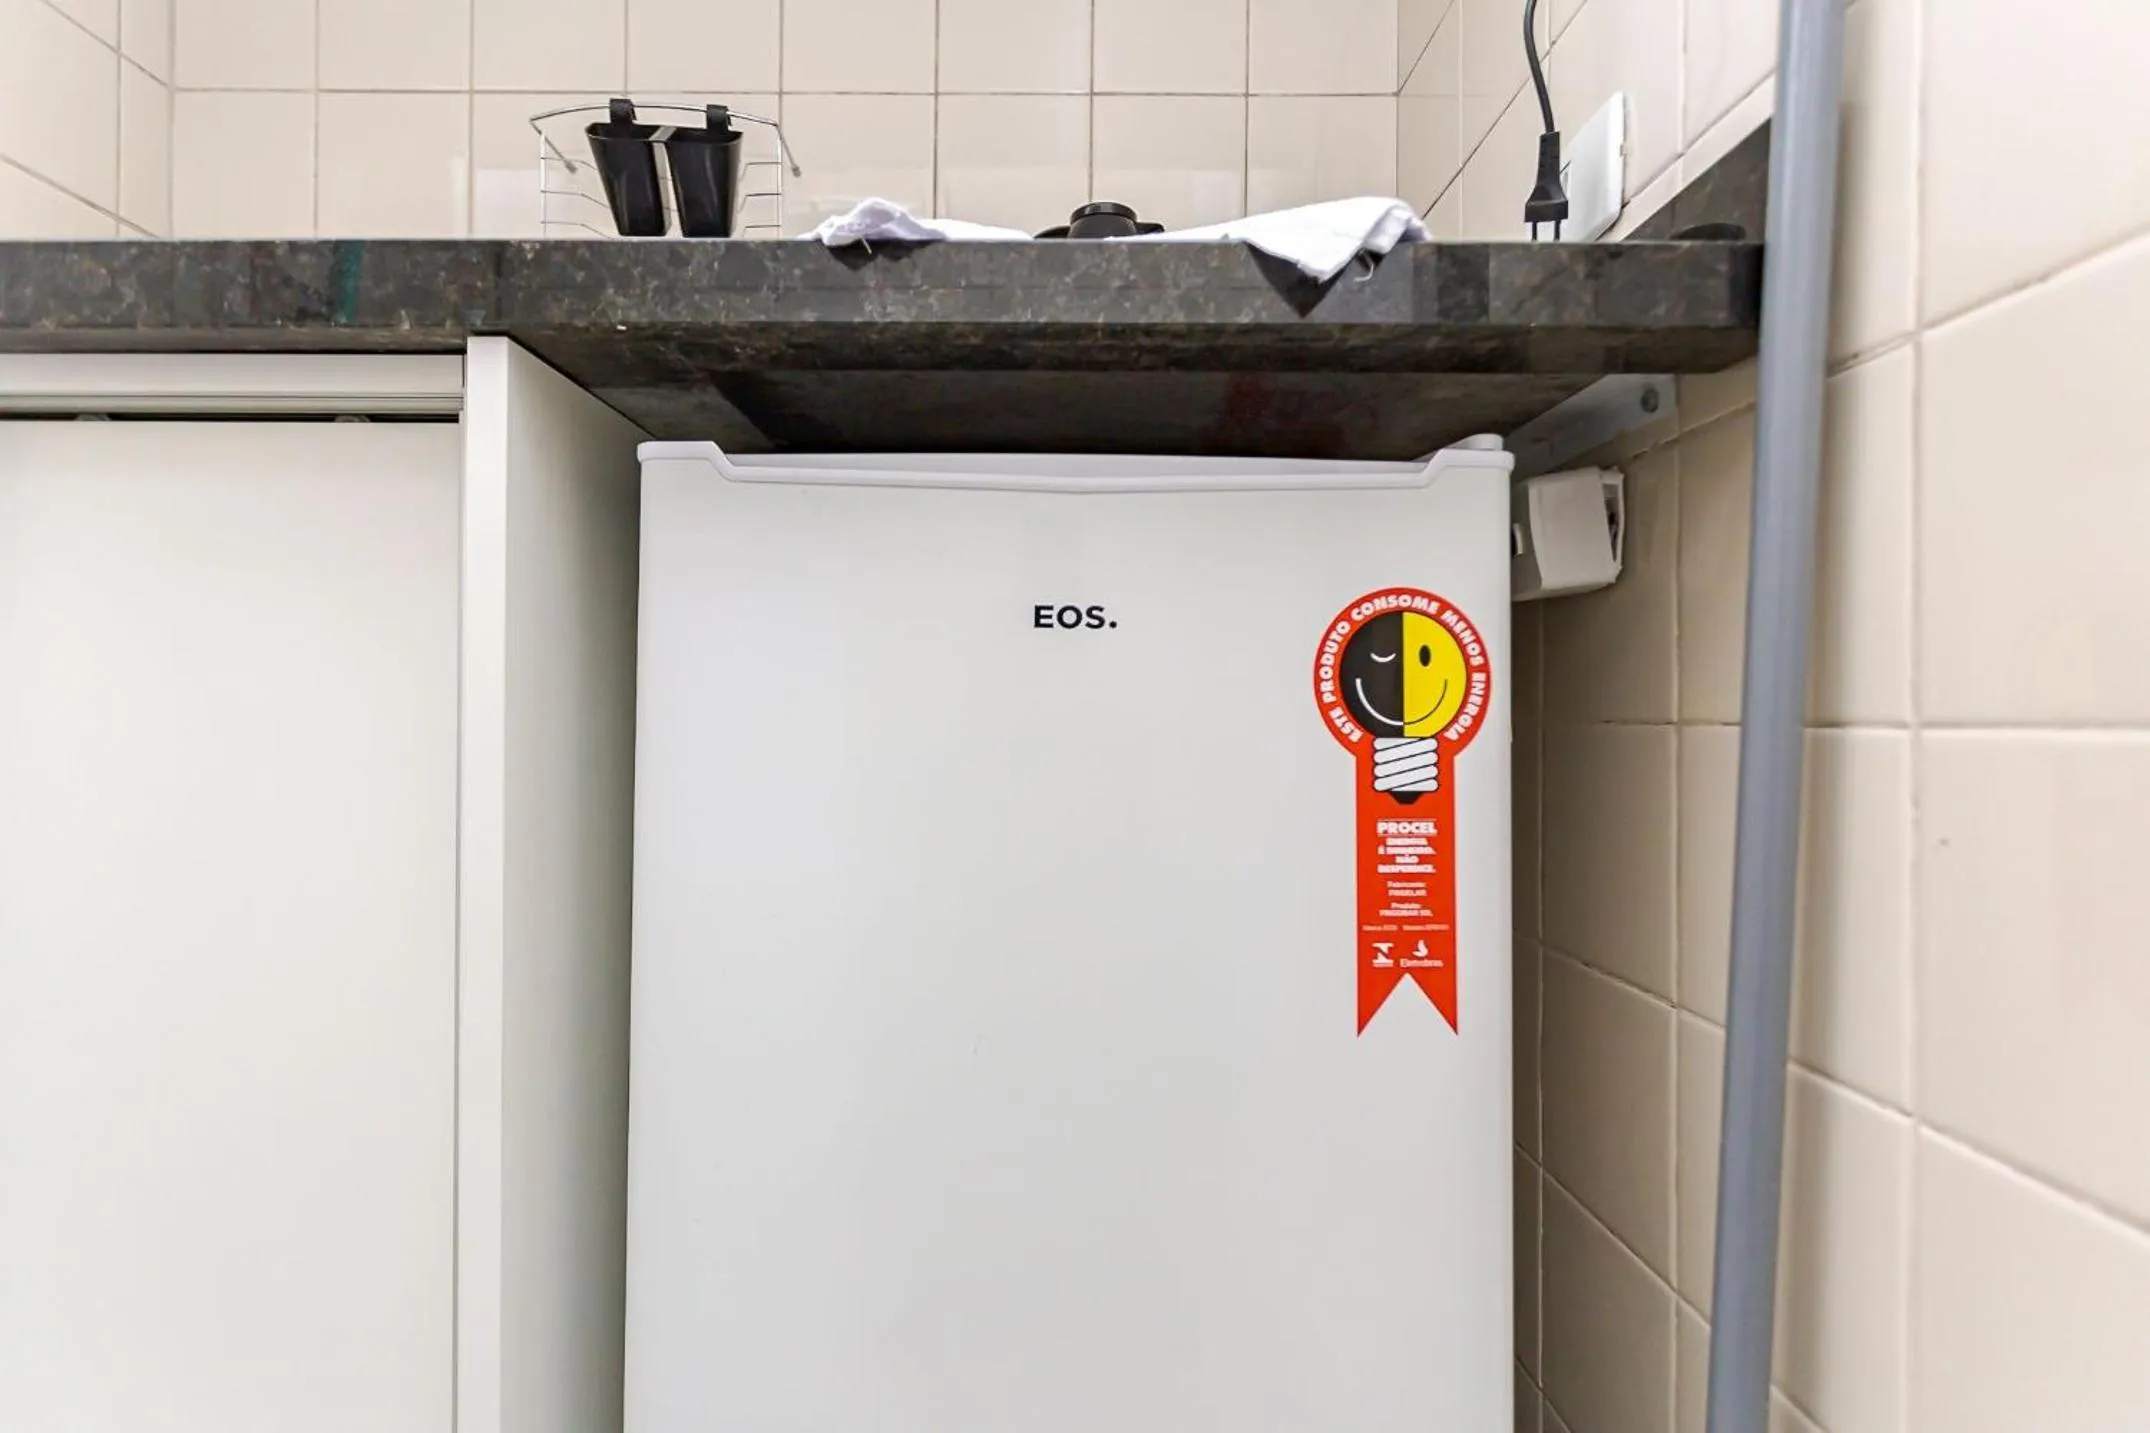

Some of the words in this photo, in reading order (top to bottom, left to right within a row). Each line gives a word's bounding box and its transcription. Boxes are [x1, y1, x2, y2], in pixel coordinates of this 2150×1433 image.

[1034, 605, 1118, 629] EOS.
[1350, 594, 1440, 621] CONSOME
[1441, 609, 1486, 667] MENOS
[1319, 620, 1351, 704] PRODUTO
[1328, 706, 1364, 743] ESTE
[1443, 671, 1487, 741] ENERGIA
[1376, 821, 1438, 834] PROCEL
